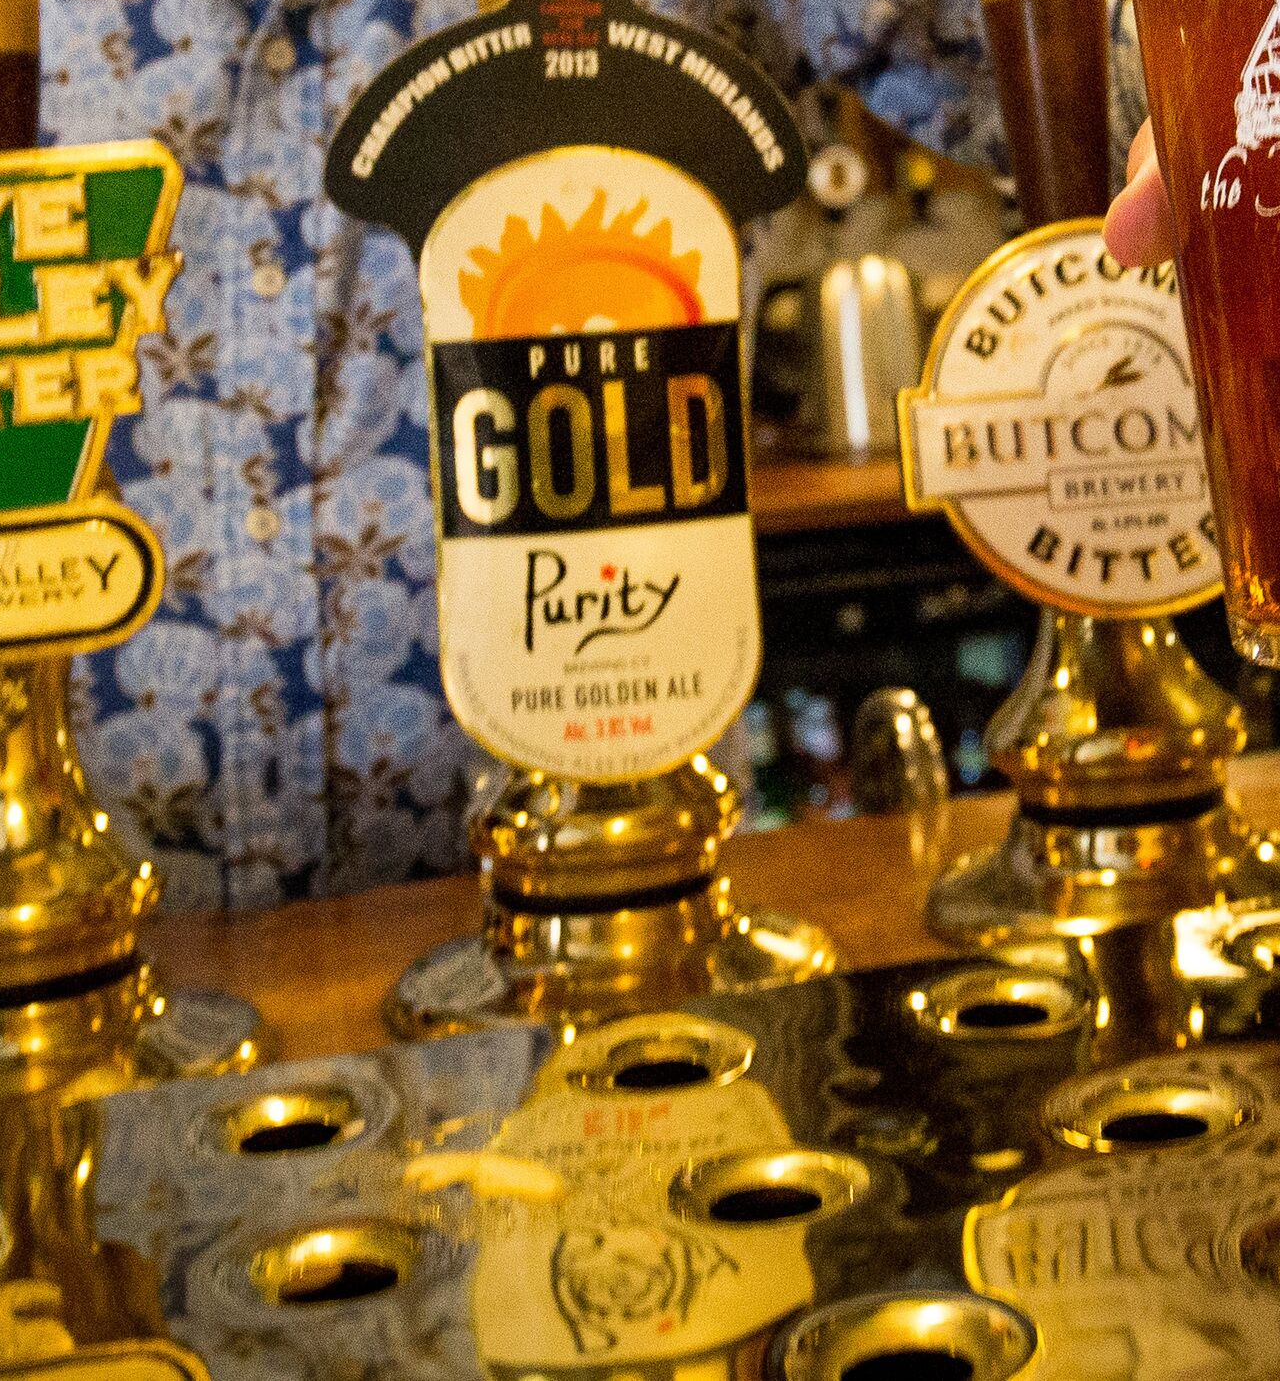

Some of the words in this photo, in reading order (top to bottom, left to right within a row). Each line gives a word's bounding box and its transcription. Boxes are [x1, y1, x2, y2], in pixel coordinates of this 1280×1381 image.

[544, 49, 599, 80] 2013
[608, 21, 682, 65] WEST
[680, 48, 785, 172] MIDLANDS
[352, 56, 451, 179] CHAMPION
[448, 22, 532, 75] BITTER
[1201, 146, 1247, 212] the
[965, 251, 1179, 359] BUTCOM
[529, 338, 650, 378] PURE
[453, 372, 728, 526] GOLD
[944, 405, 1201, 468] BUTCOM
[1065, 471, 1184, 500] BREWERY
[1027, 511, 1218, 585] BITTER
[524, 548, 681, 655] Purity
[511, 685, 565, 714] PURE
[575, 678, 658, 711] GOLDEN
[665, 671, 703, 700] ALE
